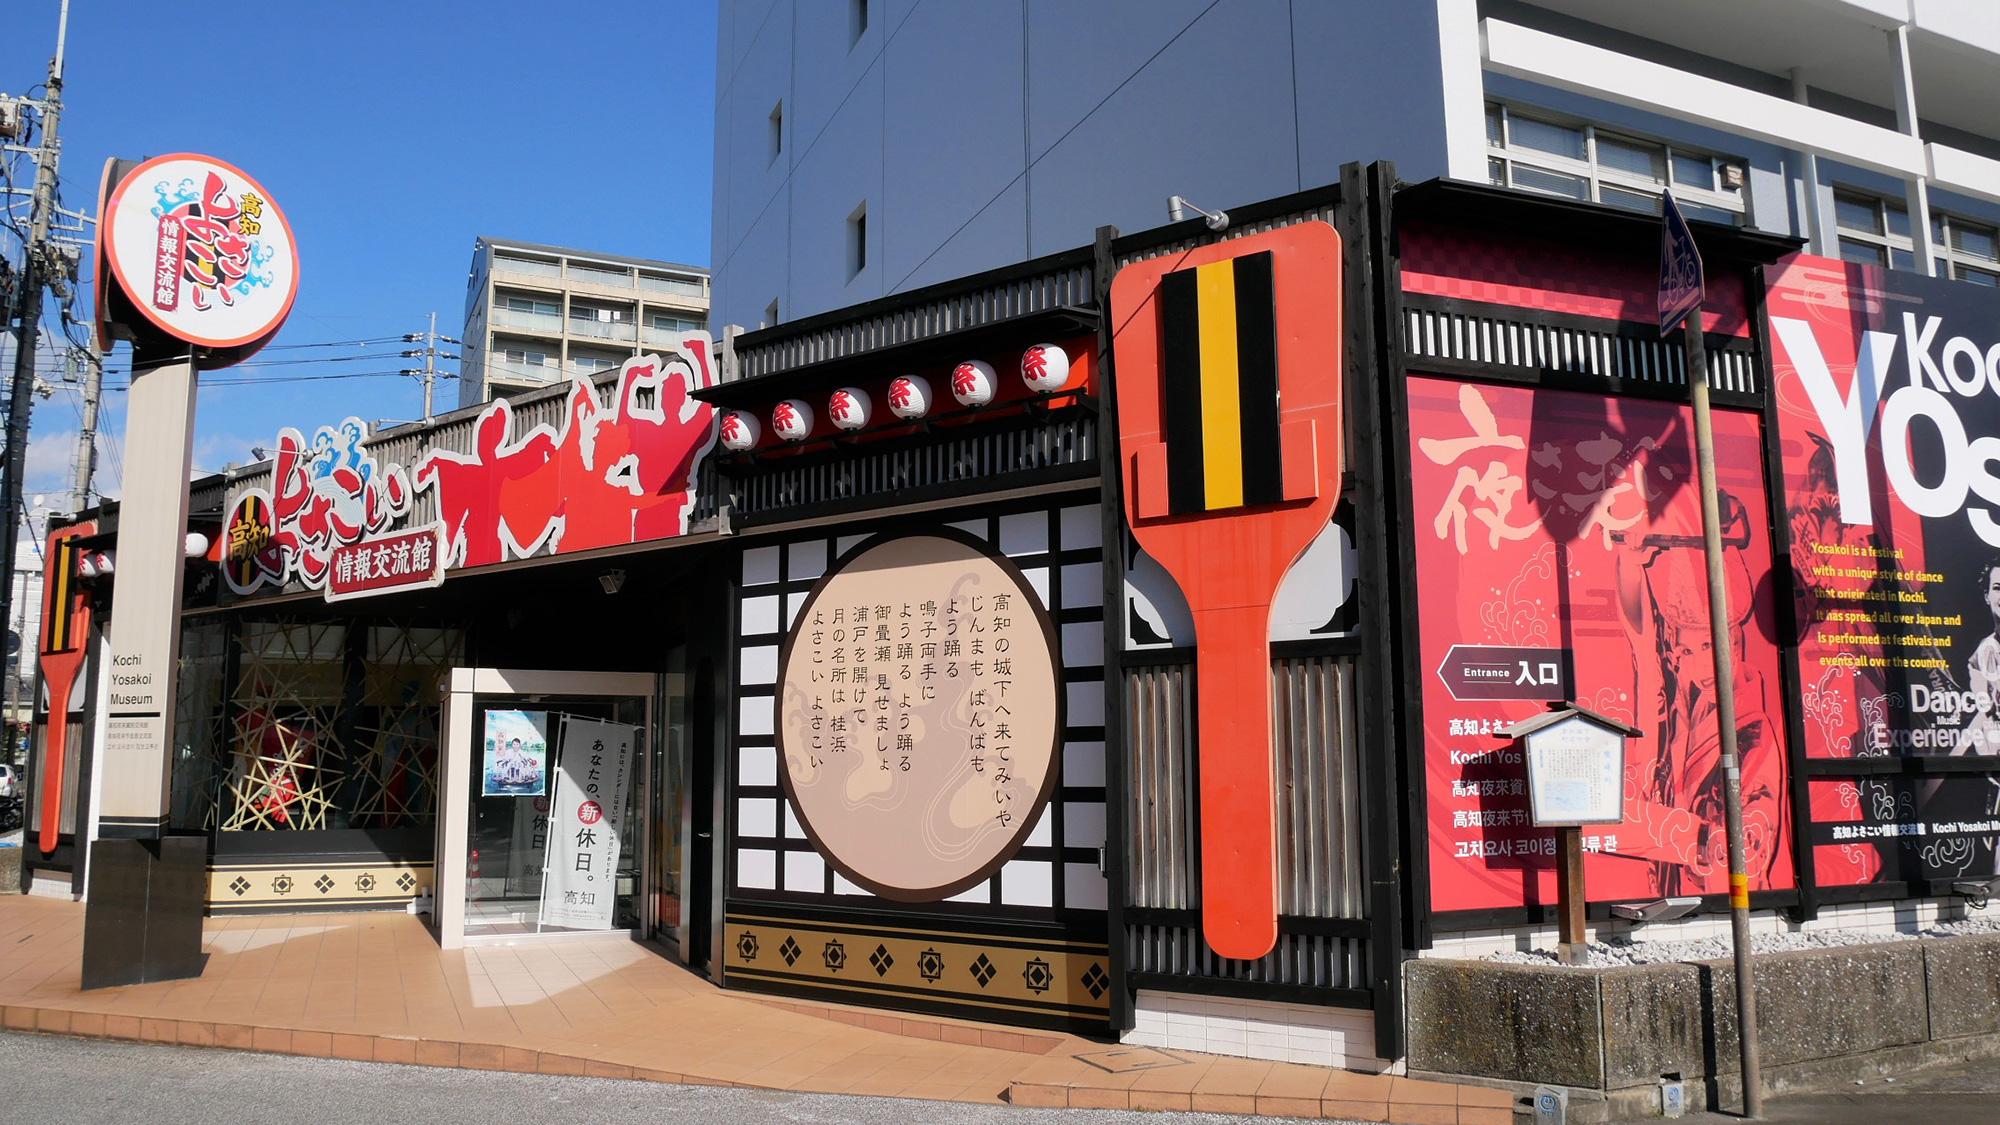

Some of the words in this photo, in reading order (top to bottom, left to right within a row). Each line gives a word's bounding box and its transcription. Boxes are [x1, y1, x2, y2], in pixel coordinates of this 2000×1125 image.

[240, 193, 263, 236] 高知
[156, 218, 180, 307] 情報交流館
[229, 518, 271, 562] 高知
[1811, 543, 1849, 555] Yosakoi
[1851, 545, 1859, 556] is
[1861, 548, 1867, 556] a
[1868, 546, 1903, 559] festival
[335, 535, 433, 584] 情報交流館
[1813, 565, 1836, 576] with
[1838, 568, 1844, 577] a
[1845, 567, 1877, 580] unique
[1879, 569, 1902, 582] style
[1904, 570, 1914, 581] of
[1916, 571, 1943, 582] dance
[1814, 588, 1835, 599] that
[1837, 589, 1886, 602] originated
[1888, 591, 1897, 601] in
[1898, 591, 1928, 603] Kochi.
[874, 604, 891, 662] 御畳瀬
[970, 595, 986, 676] じんまも
[1816, 610, 1824, 620] It
[1826, 610, 1843, 622] has
[1845, 611, 1877, 625] spread
[1879, 612, 1891, 623] all
[1893, 614, 1914, 623] over
[1916, 614, 1942, 627] Japan
[1943, 615, 1961, 625] and
[811, 610, 824, 682] よさこい
[897, 602, 914, 680] よう踊る
[919, 600, 938, 700] 鳴子両手に
[944, 598, 961, 678] よう踊る
[1817, 632, 1826, 642] is
[1828, 633, 1879, 645] performed
[1881, 635, 1891, 645] at
[1893, 634, 1932, 646] festivals
[1933, 635, 1951, 646] and
[113, 654, 142, 666] Kochi
[830, 608, 847, 704] 月の名所は
[852, 605, 869, 724] 浦戸を開けて
[1464, 668, 1510, 677] Entrance
[1819, 656, 1853, 666] events
[1855, 656, 1867, 666] all
[1869, 657, 1891, 667] over
[1893, 656, 1909, 667] the
[1910, 657, 1949, 670] country.
[112, 673, 152, 685] Yosakoi
[1515, 661, 1558, 686] 入口
[110, 694, 153, 705] Museum
[993, 593, 1012, 828] 高知の城下へ来てみいや
[1910, 684, 1991, 713] Dance
[810, 695, 824, 769] よさこい
[830, 715, 847, 753] 桂浜
[874, 673, 892, 772] 見せましょ
[896, 692, 914, 772] よう踊る
[969, 689, 986, 773] ばんばも
[1874, 723, 1985, 757] Experience
[1450, 750, 1492, 765] Kochi
[1452, 779, 1527, 797] 高知夜來資
[1453, 809, 1530, 829] 高知夜来节
[1832, 823, 1926, 839] 高知よさこい情報交流館
[1932, 822, 1956, 833] Kochi
[1958, 820, 1990, 832] Yosakoi
[564, 890, 595, 905] 高知
